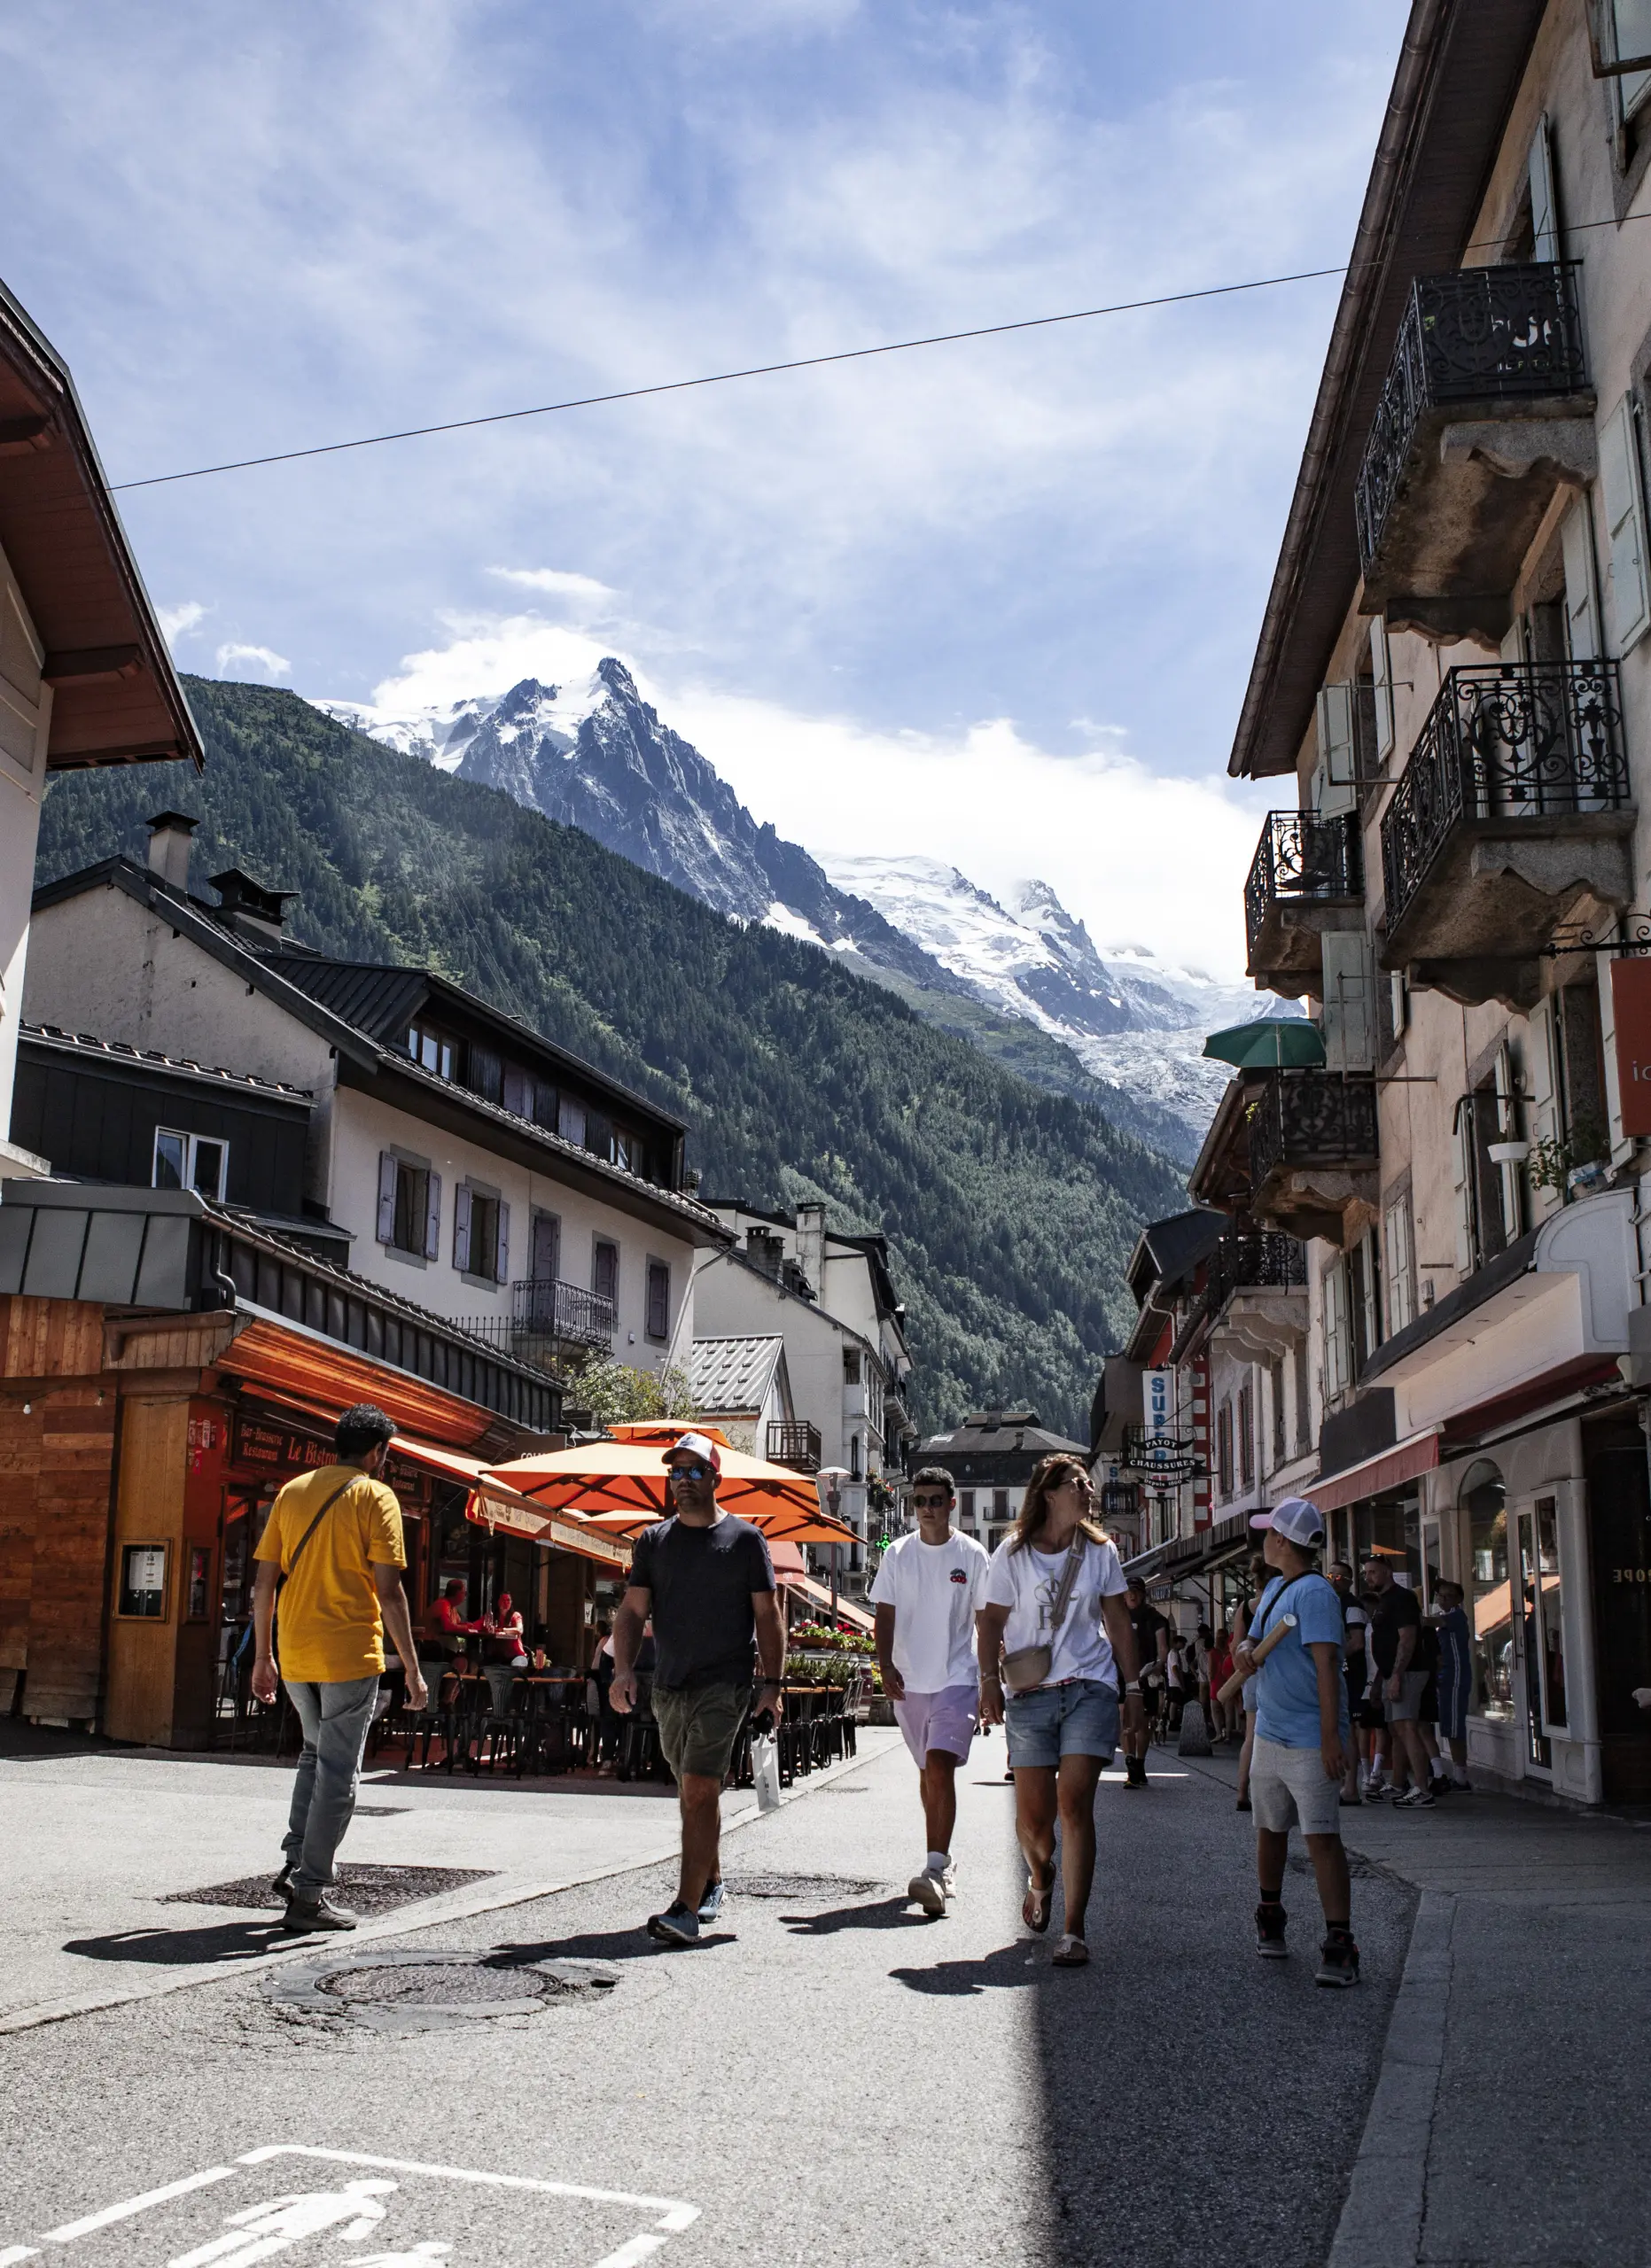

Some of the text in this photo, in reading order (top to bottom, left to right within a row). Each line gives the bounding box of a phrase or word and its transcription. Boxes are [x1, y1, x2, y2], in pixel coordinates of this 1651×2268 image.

[287, 1436, 302, 1461] Le
[1146, 1439, 1178, 1449] PAYOT
[1130, 1459, 1195, 1470] CHAUSSURES
